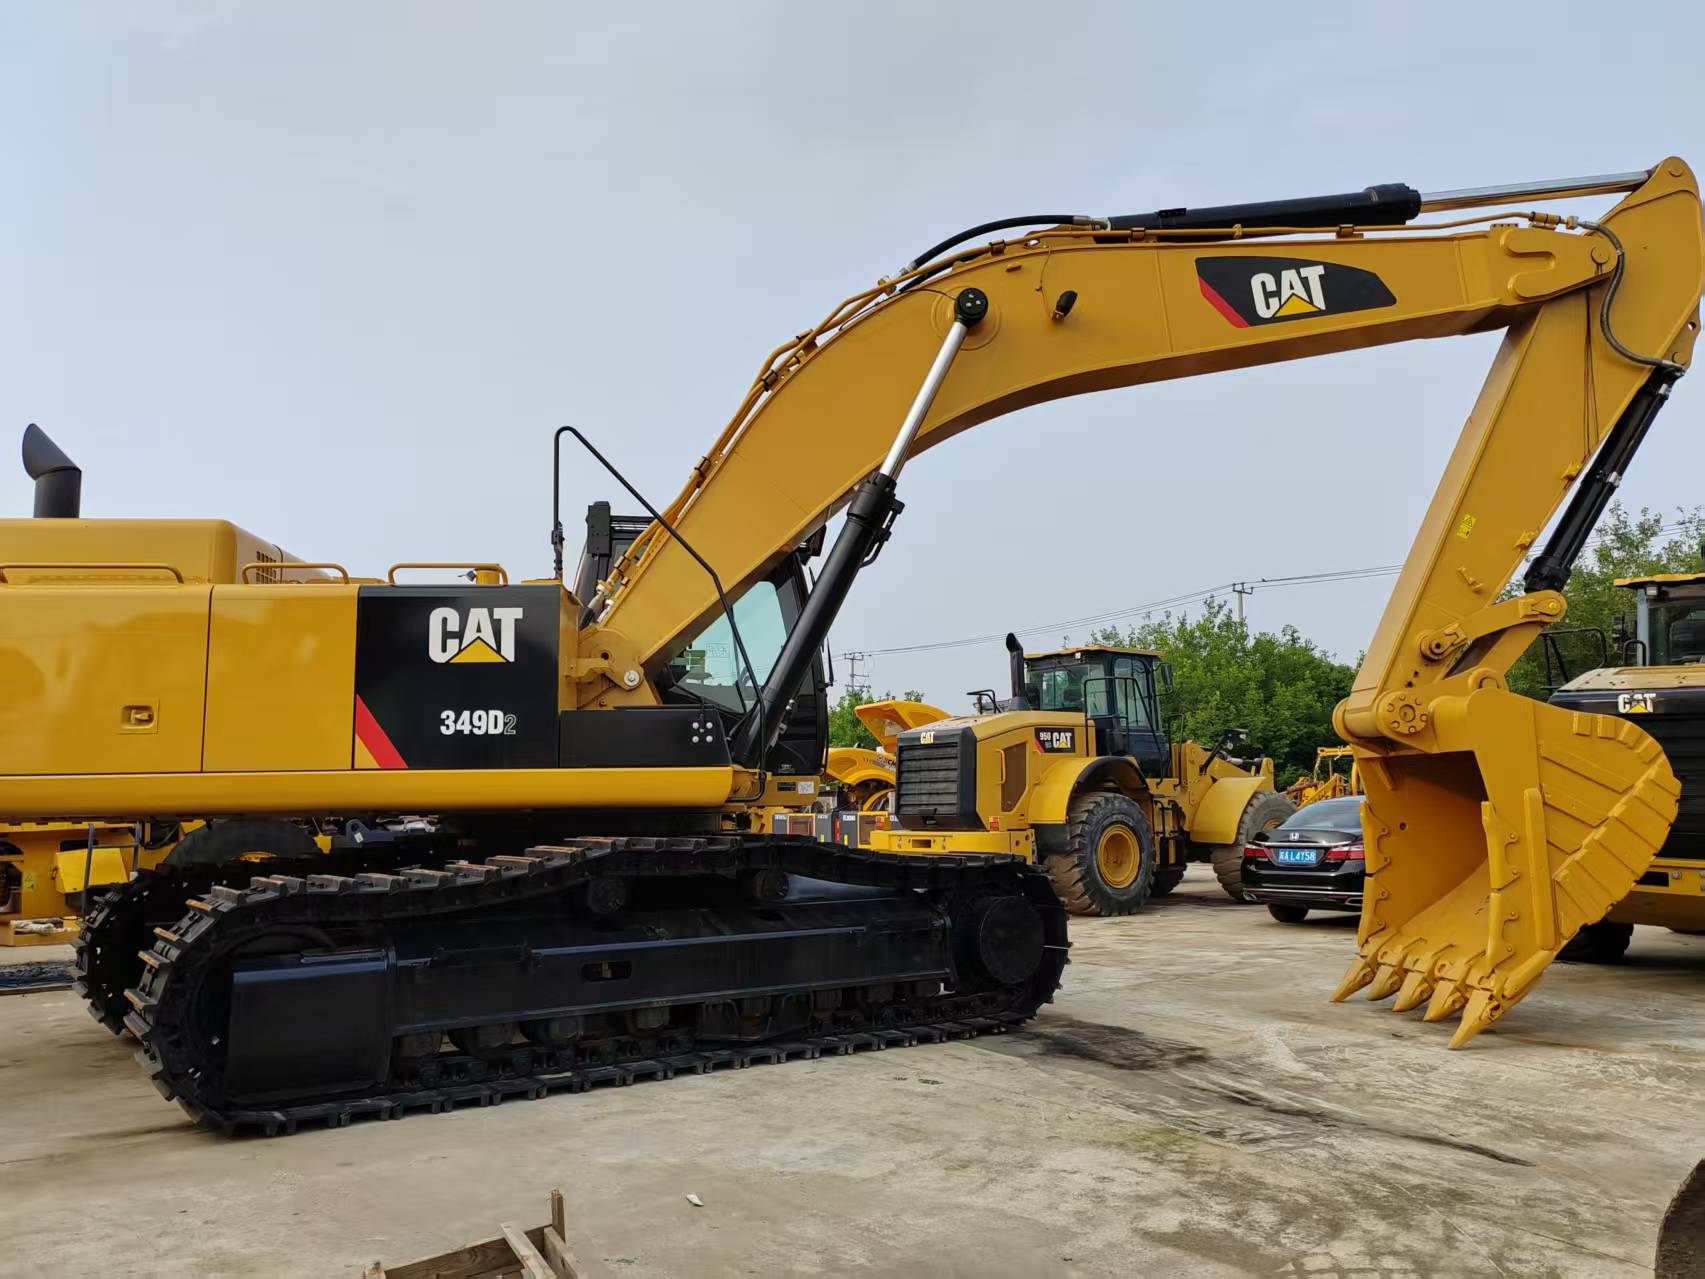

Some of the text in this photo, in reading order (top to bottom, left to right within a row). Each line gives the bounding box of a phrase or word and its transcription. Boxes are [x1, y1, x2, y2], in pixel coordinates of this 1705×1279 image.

[1250, 264, 1326, 319] CAT
[428, 606, 524, 664] CAT
[1617, 693, 1657, 714] CAT
[440, 709, 517, 736] 349D2
[920, 731, 935, 744] CAT
[1052, 731, 1072, 748] CAT
